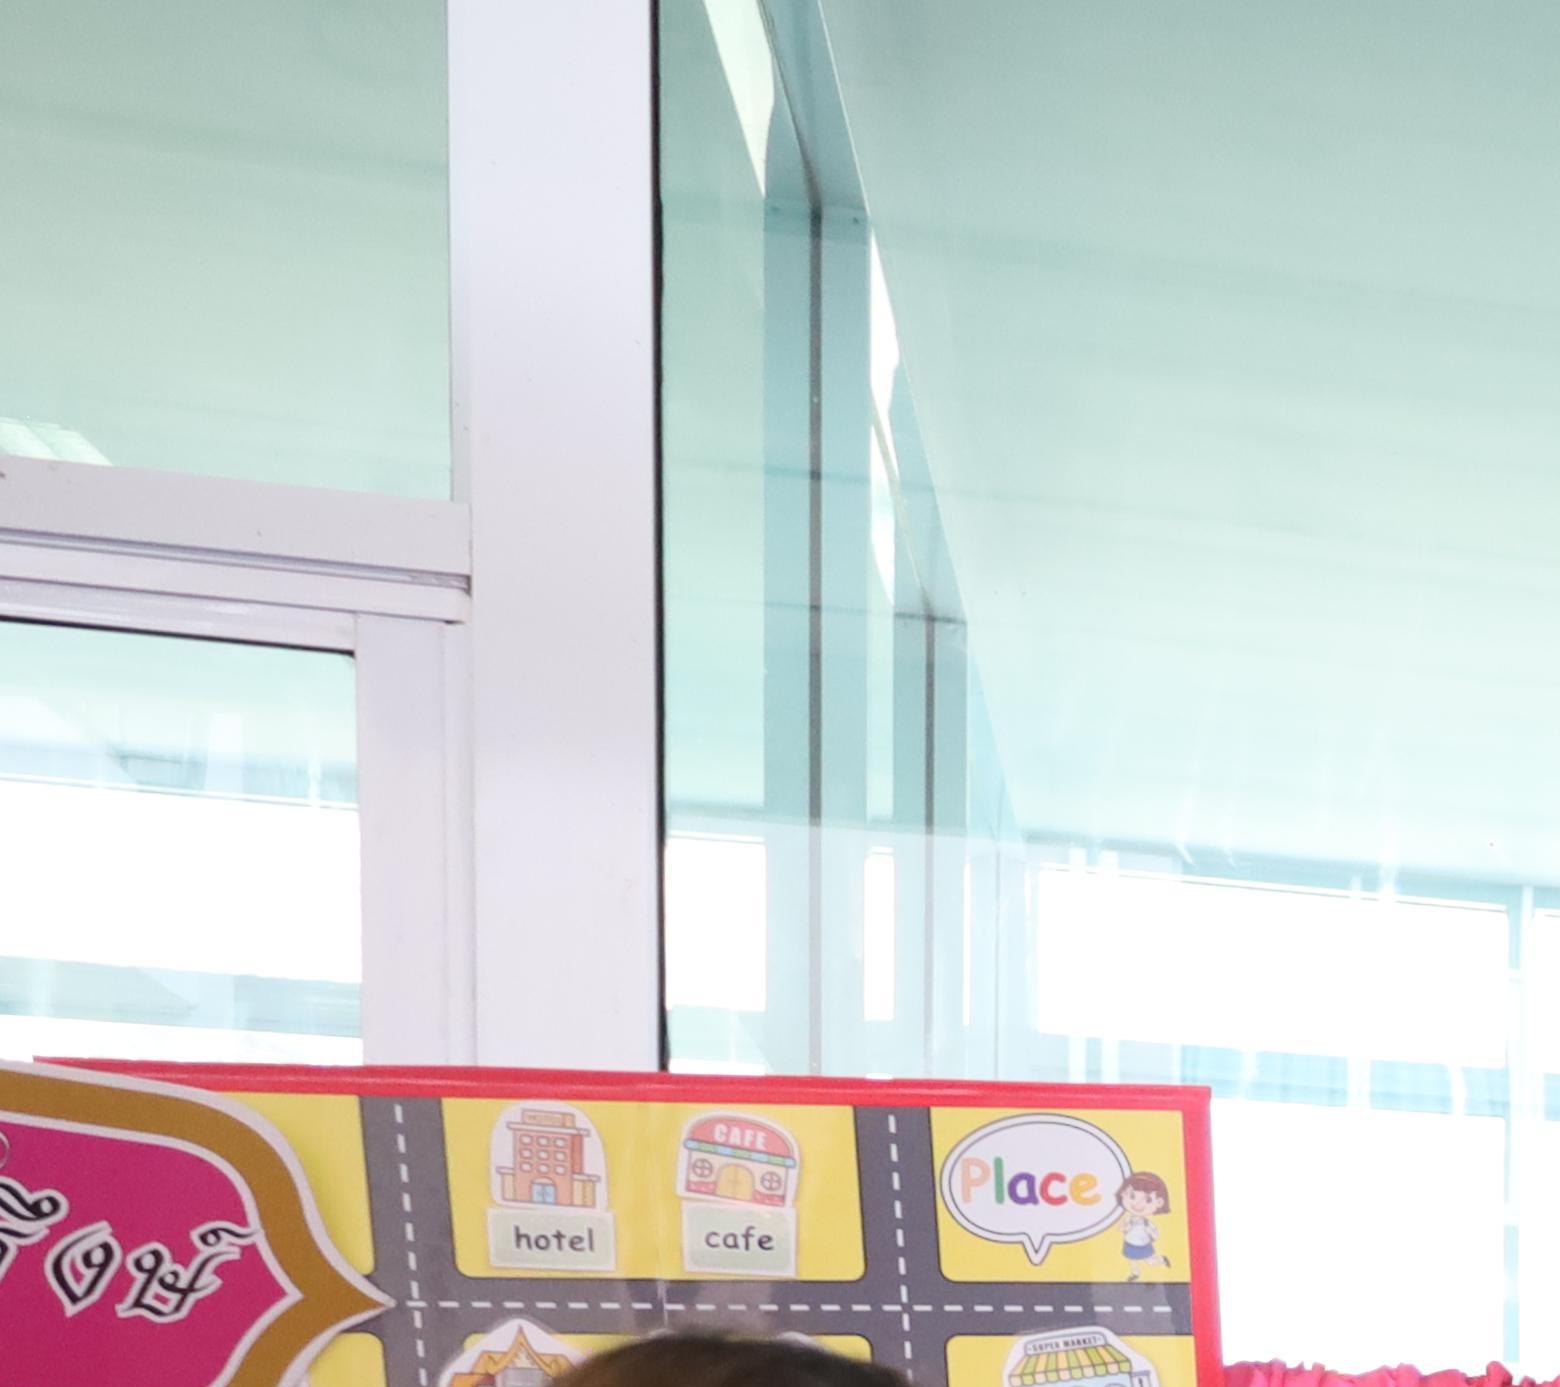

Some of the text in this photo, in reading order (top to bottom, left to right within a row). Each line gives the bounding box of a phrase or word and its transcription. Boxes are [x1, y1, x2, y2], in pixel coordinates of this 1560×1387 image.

[713, 1123, 767, 1150] CAFE
[961, 1156, 1102, 1206] Place
[514, 1226, 595, 1254] hotel
[705, 1226, 774, 1253] cafe
